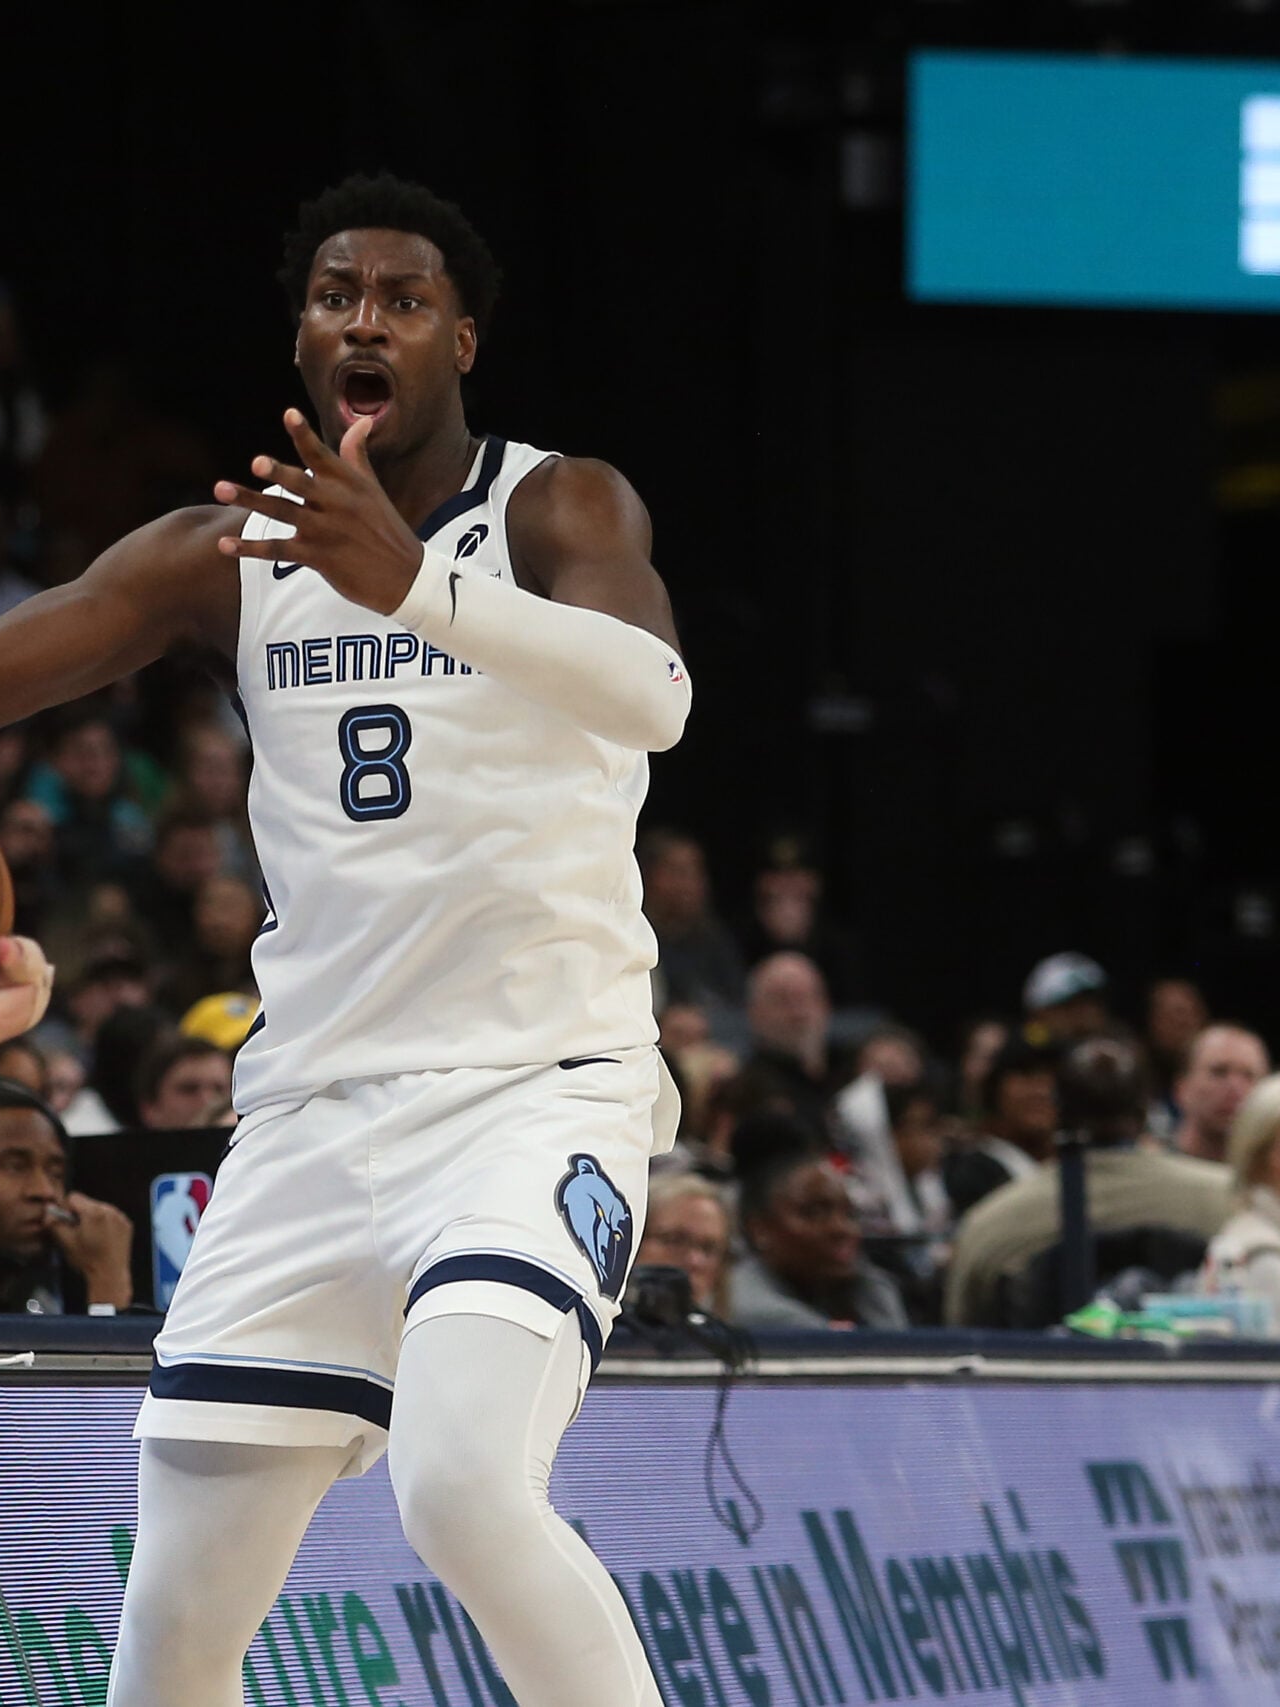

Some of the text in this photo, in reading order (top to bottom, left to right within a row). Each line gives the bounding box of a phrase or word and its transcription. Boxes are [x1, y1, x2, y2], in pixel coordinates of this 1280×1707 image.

[266, 633, 485, 690] MEMPH
[338, 703, 412, 823] 8
[724, 1497, 846, 1706] in
[802, 1487, 1107, 1707] Memphis
